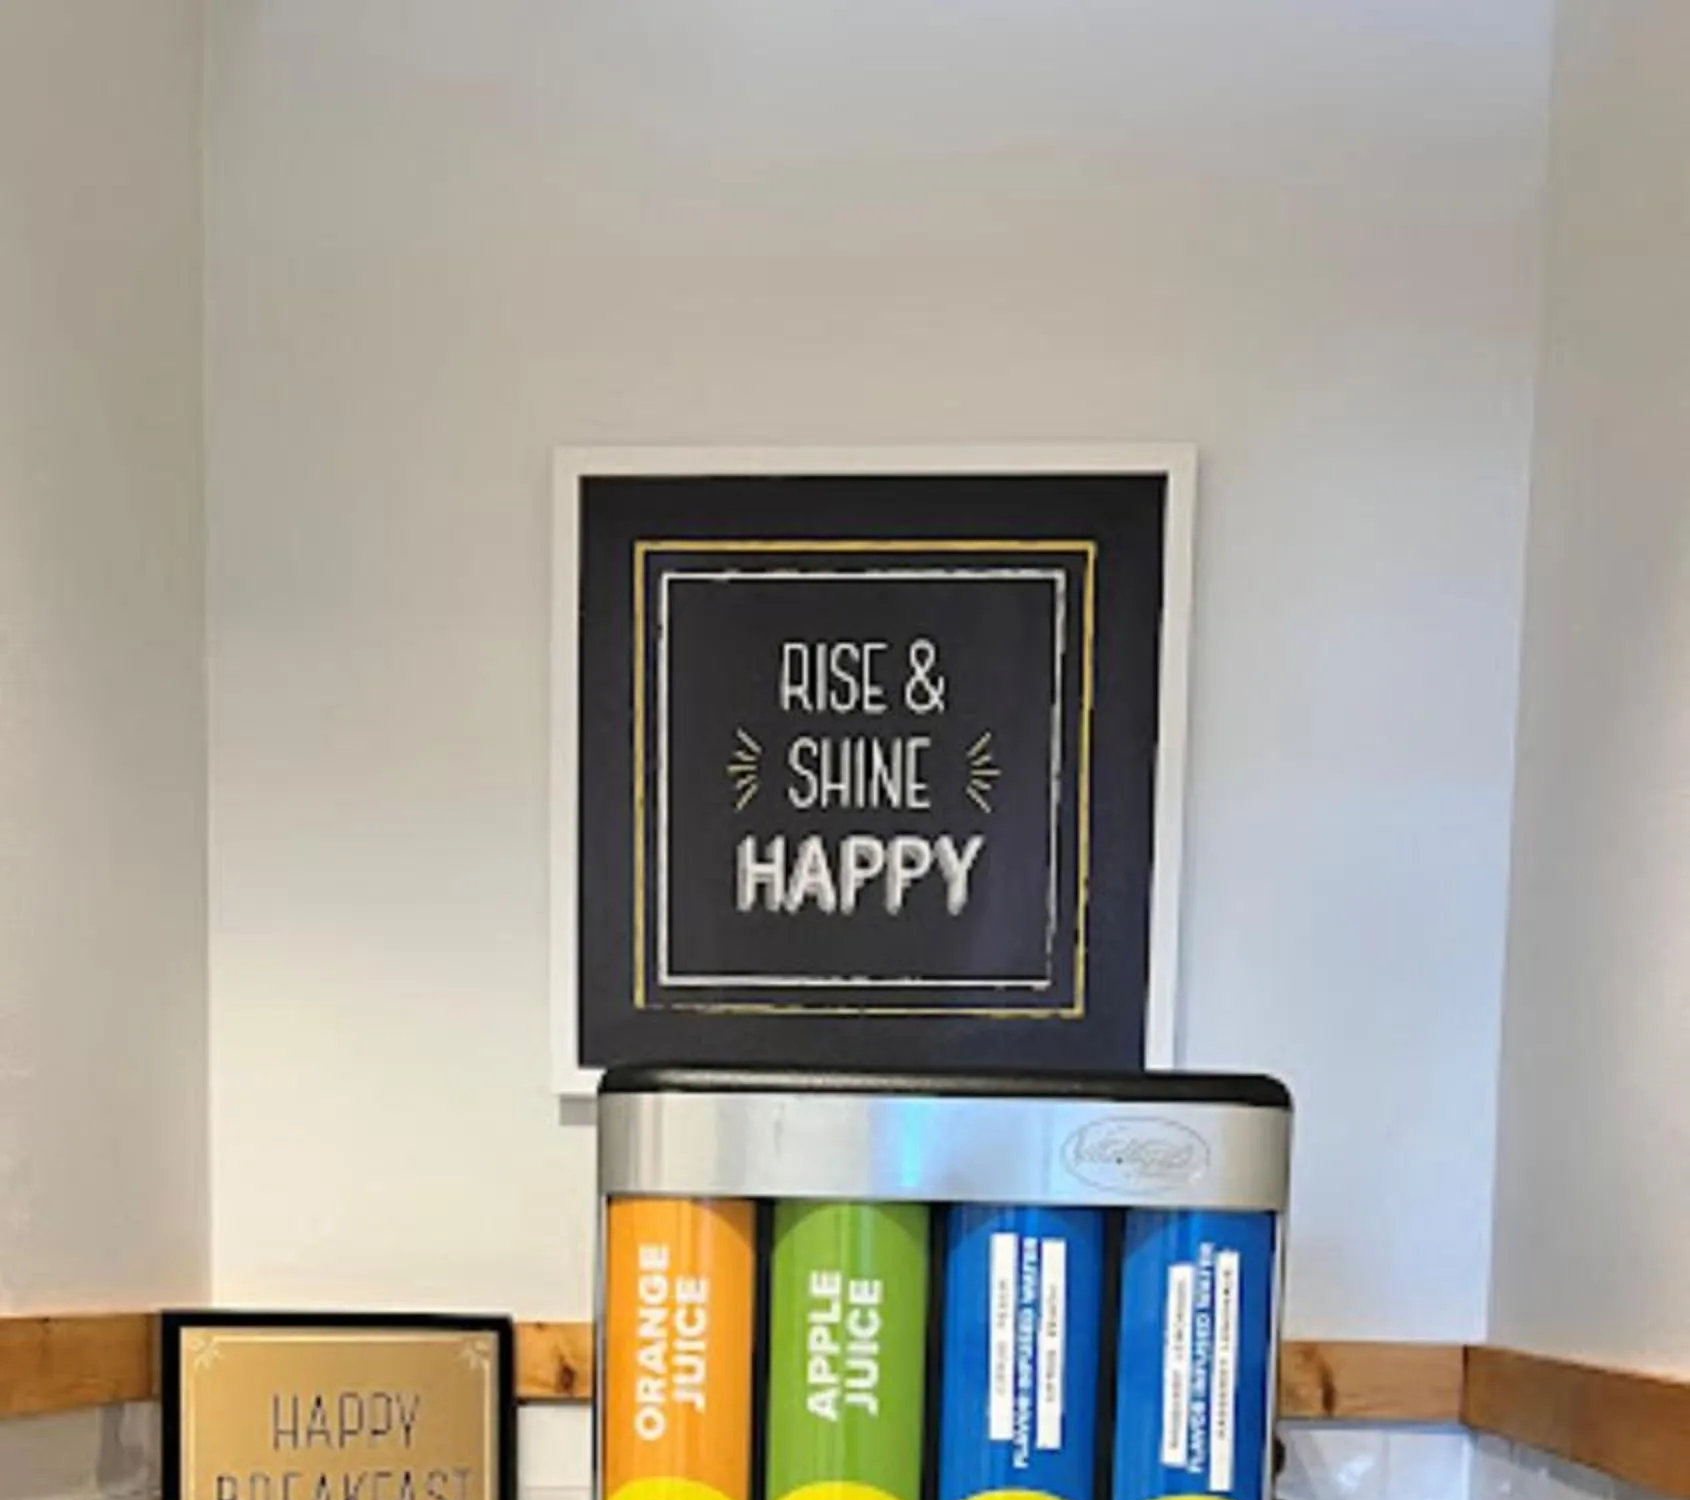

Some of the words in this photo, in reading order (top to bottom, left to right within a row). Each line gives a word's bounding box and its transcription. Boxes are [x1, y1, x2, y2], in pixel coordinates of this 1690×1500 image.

[780, 641, 888, 713] RISE
[905, 638, 945, 714] &
[787, 736, 932, 810] SHINE
[736, 834, 985, 915] HAPPY
[633, 1244, 671, 1442] ORANGE
[672, 1276, 708, 1415] JUICE
[806, 1269, 843, 1423] APPLE
[844, 1278, 884, 1420] JUICE
[272, 1391, 421, 1451] HAPPY
